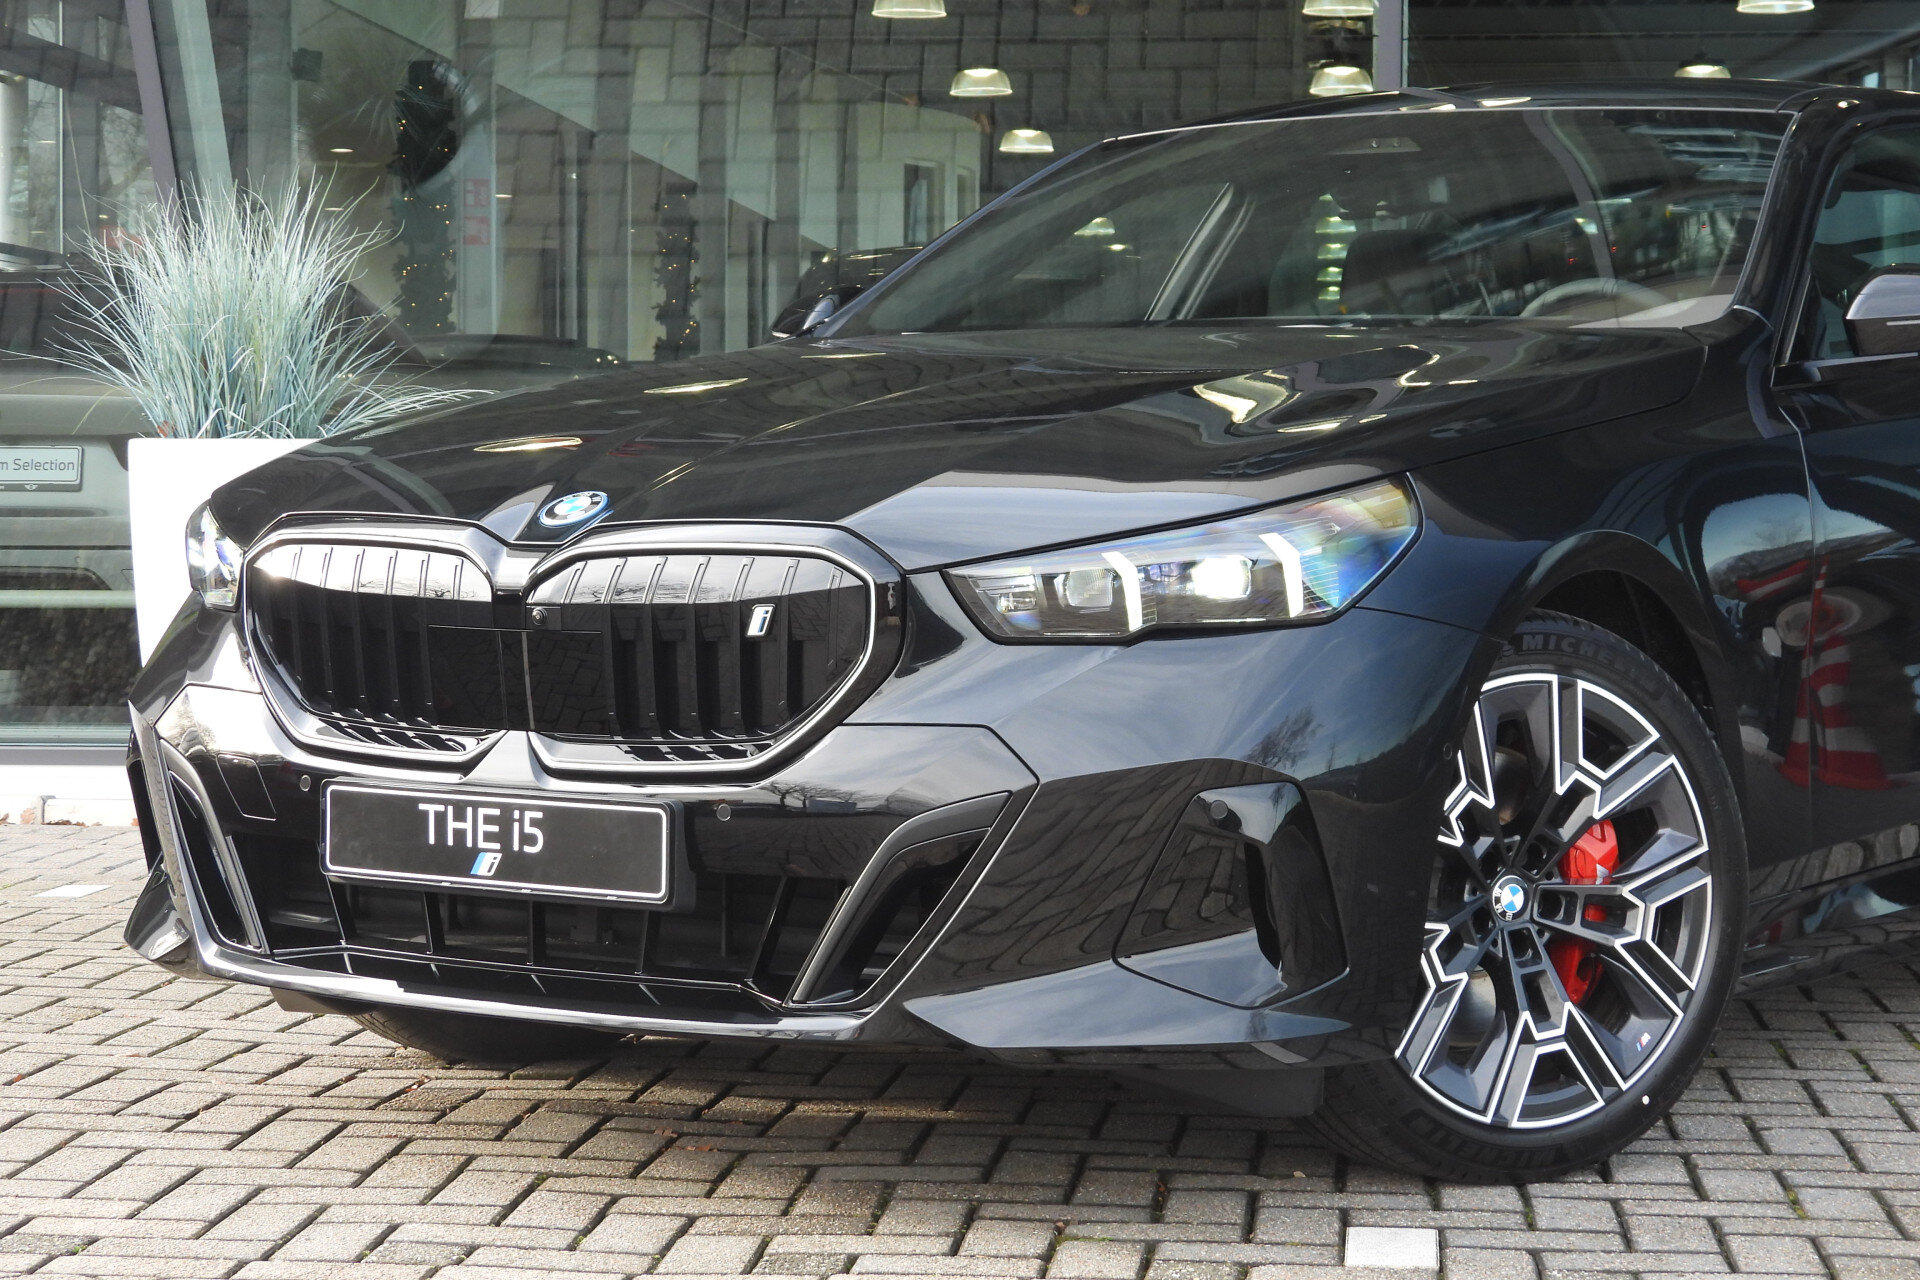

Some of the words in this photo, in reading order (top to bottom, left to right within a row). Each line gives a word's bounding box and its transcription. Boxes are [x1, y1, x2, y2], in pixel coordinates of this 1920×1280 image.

[13, 458, 75, 471] Selection
[418, 803, 501, 850] THE
[512, 809, 544, 853] i5
